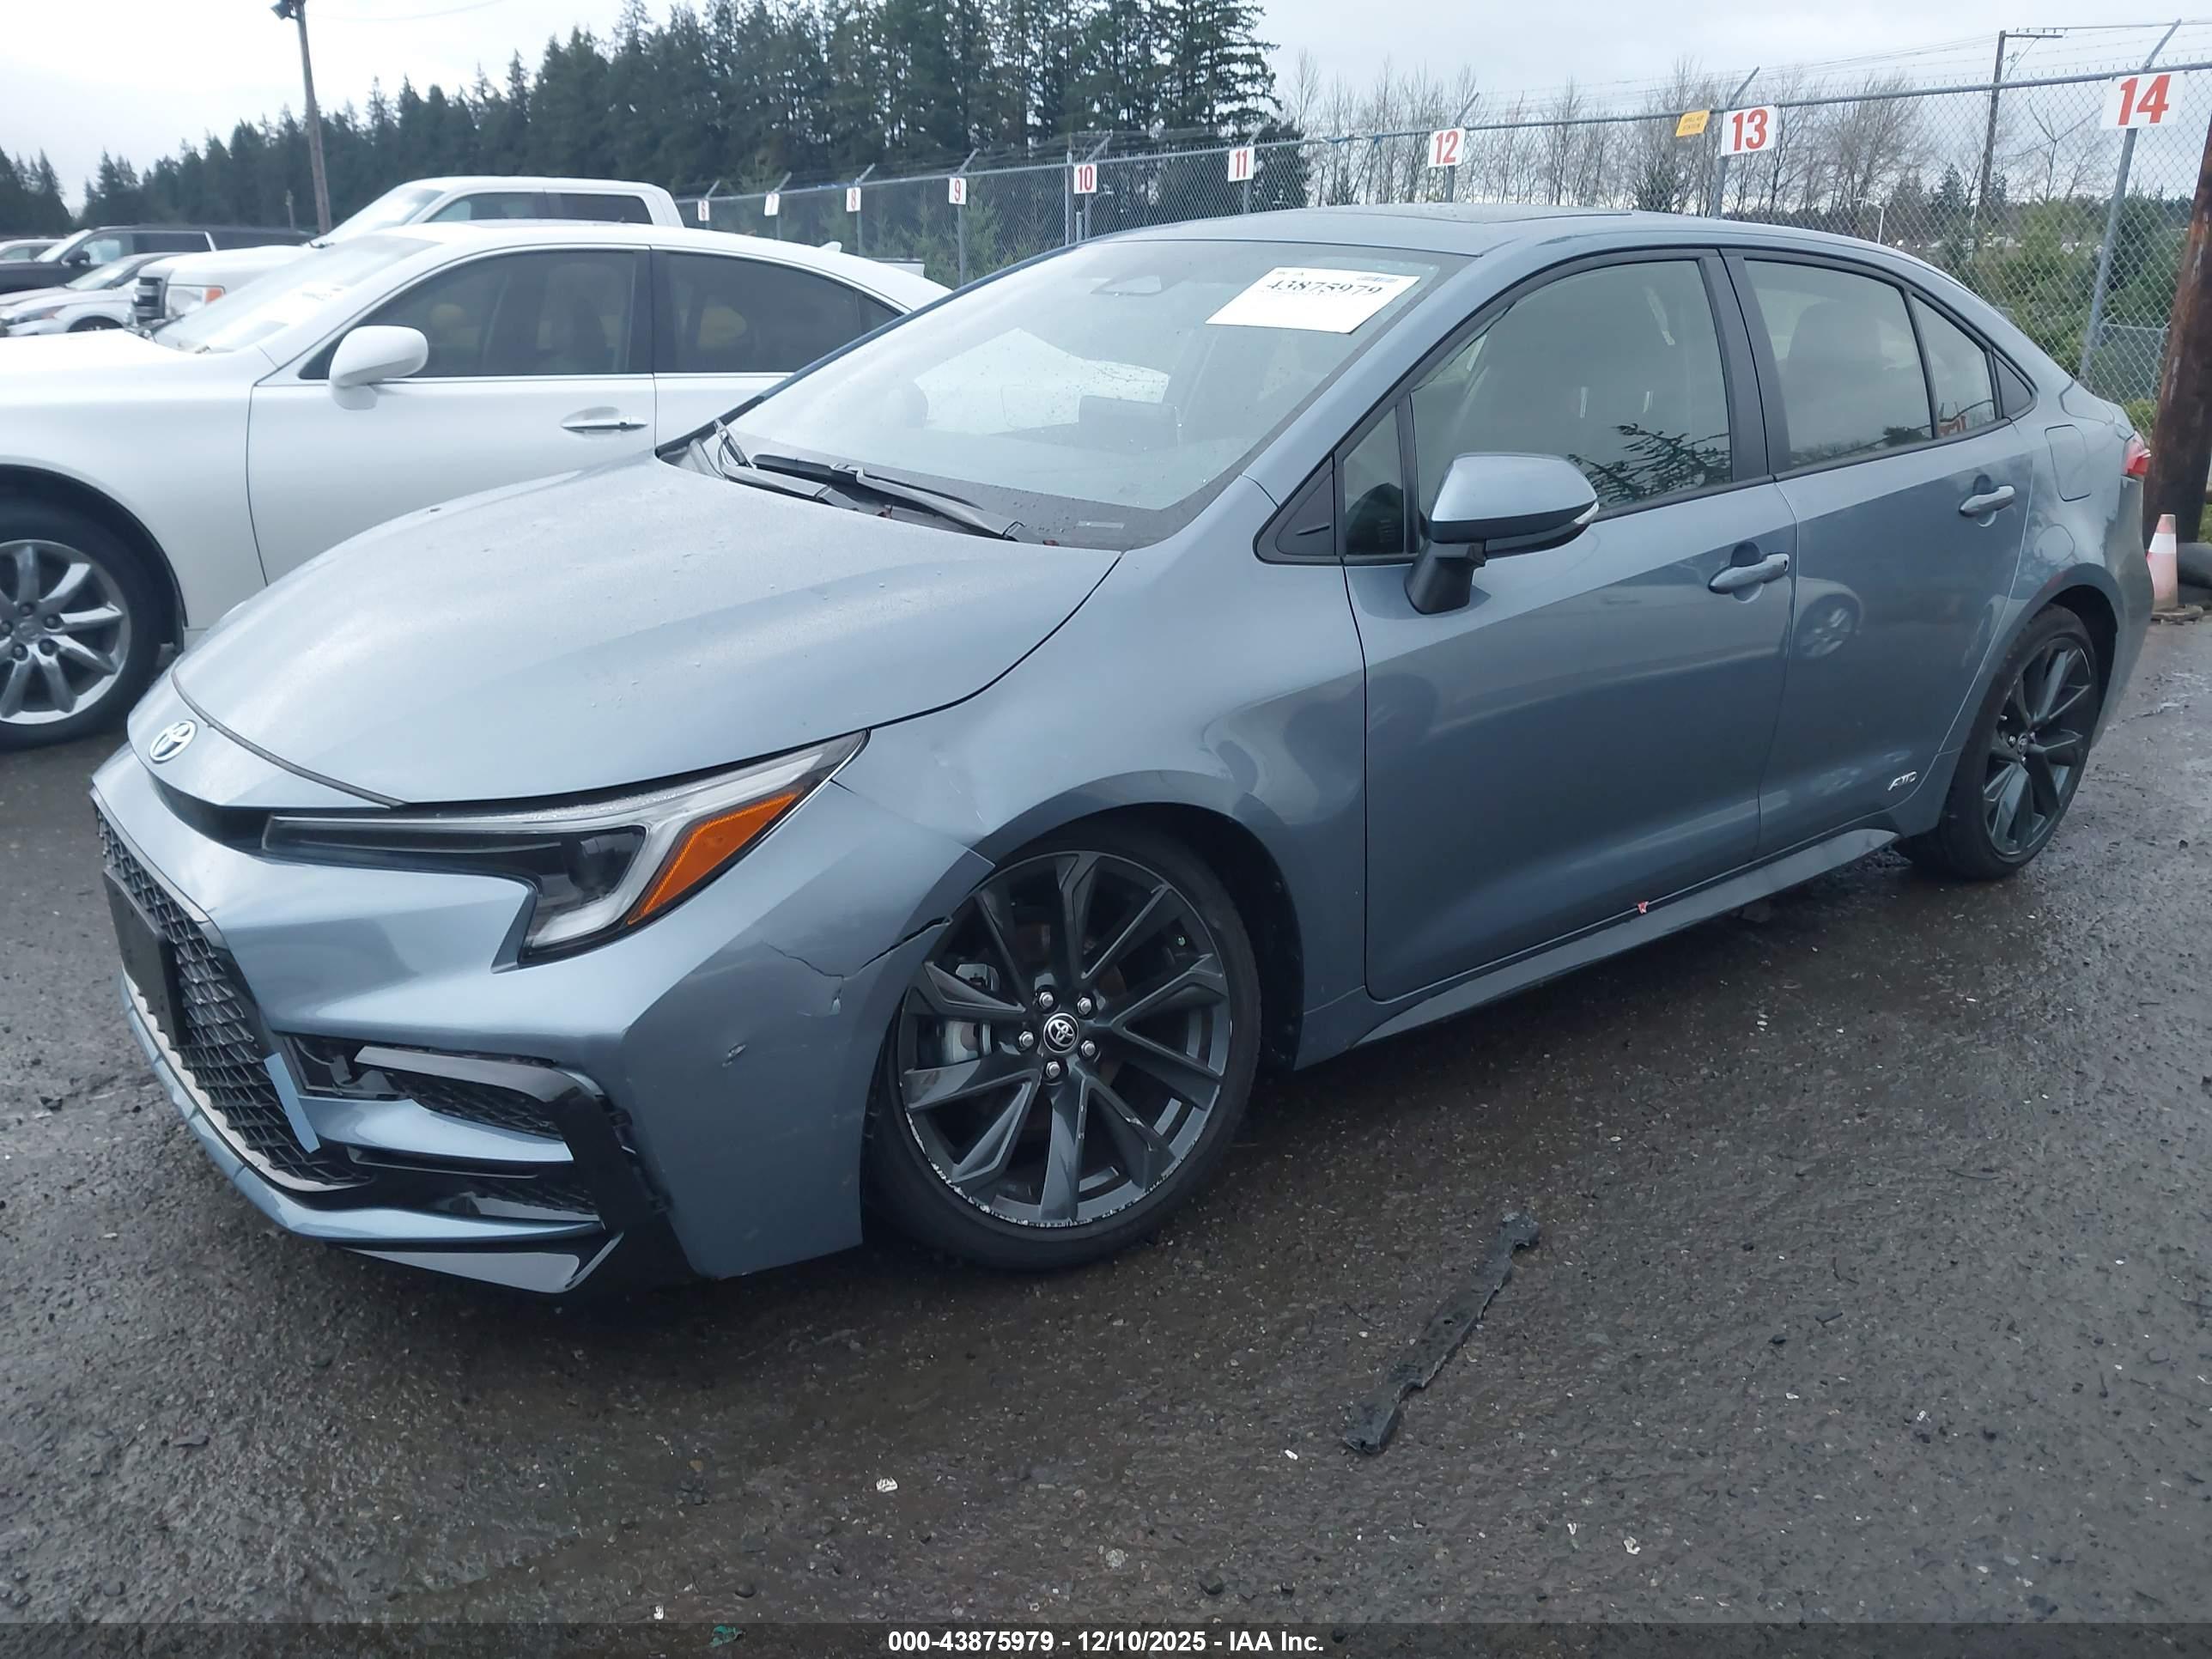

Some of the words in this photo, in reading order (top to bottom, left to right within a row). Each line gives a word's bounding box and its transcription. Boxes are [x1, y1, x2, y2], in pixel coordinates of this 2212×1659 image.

[2118, 74, 2172, 125] 14
[1732, 109, 1769, 152] 13
[1436, 131, 1459, 164] 12
[1078, 165, 1093, 191] 10
[1235, 149, 1249, 179] 11
[851, 189, 856, 210] 8
[954, 179, 961, 203] 9
